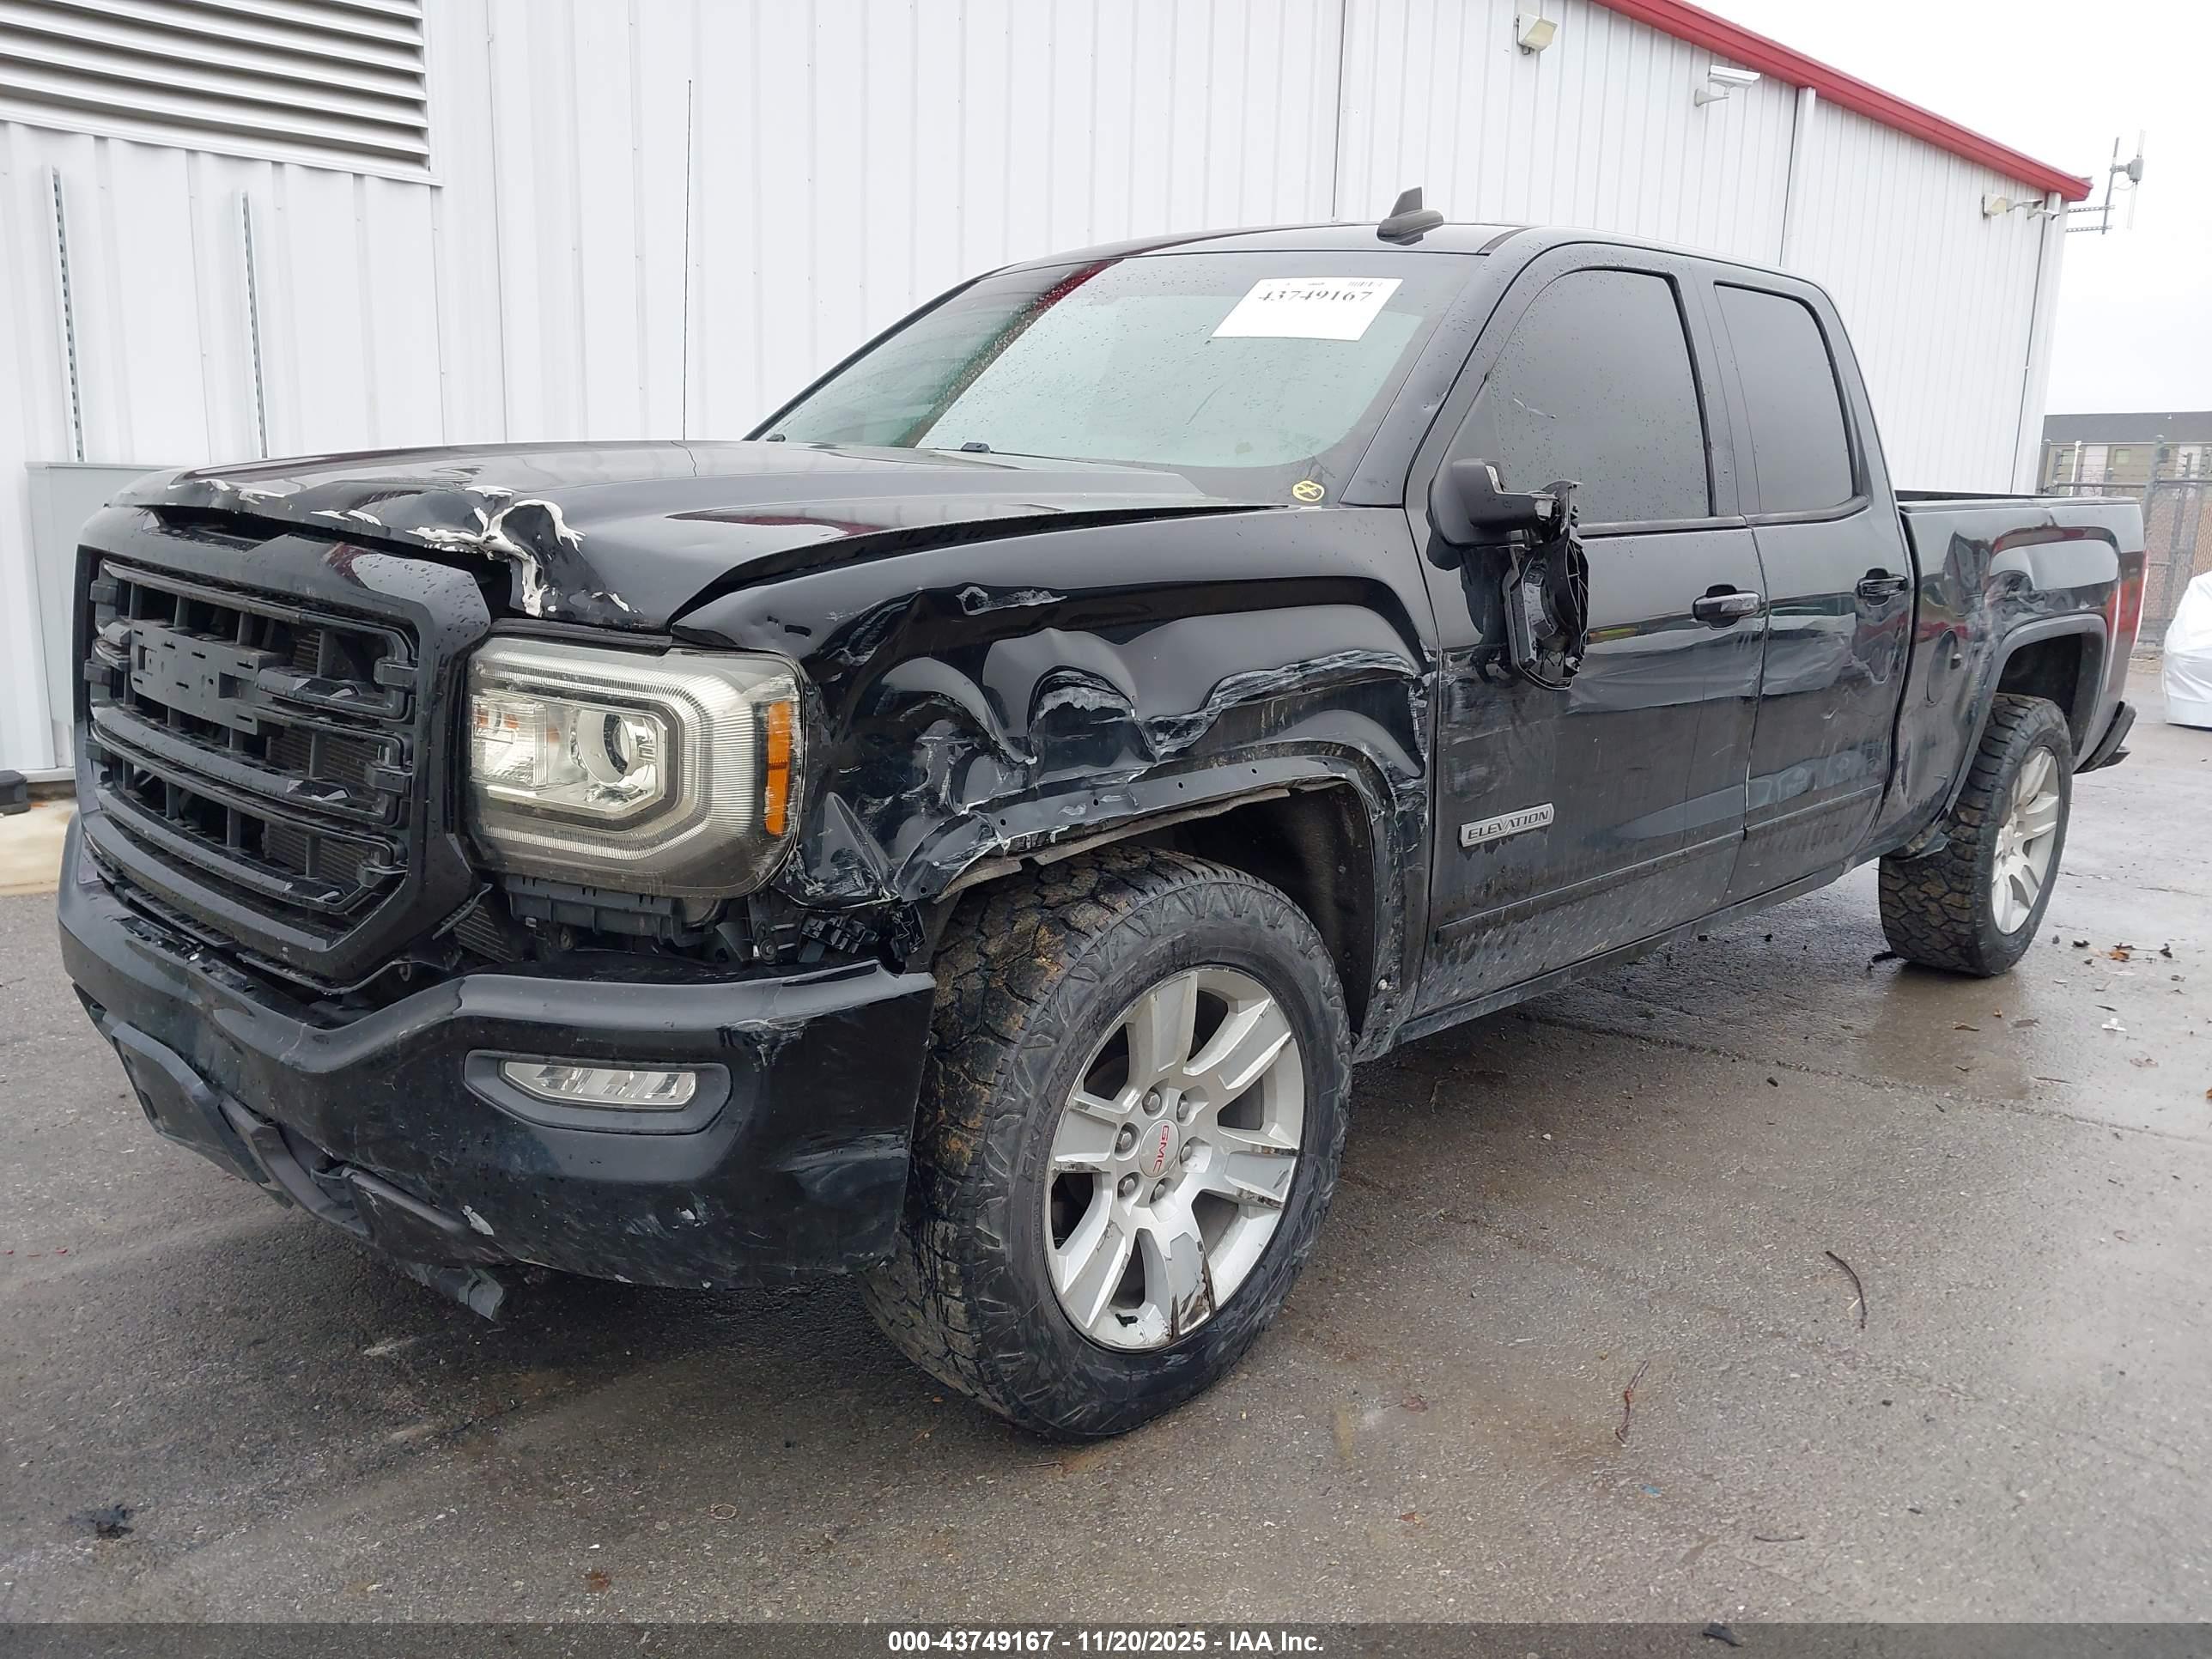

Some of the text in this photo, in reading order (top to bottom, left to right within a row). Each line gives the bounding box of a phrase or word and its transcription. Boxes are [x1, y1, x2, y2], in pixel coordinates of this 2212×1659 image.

[1258, 290, 1373, 302] 43749167
[1468, 811, 1548, 840] ELEVATION
[1153, 1125, 1170, 1173] GMC
